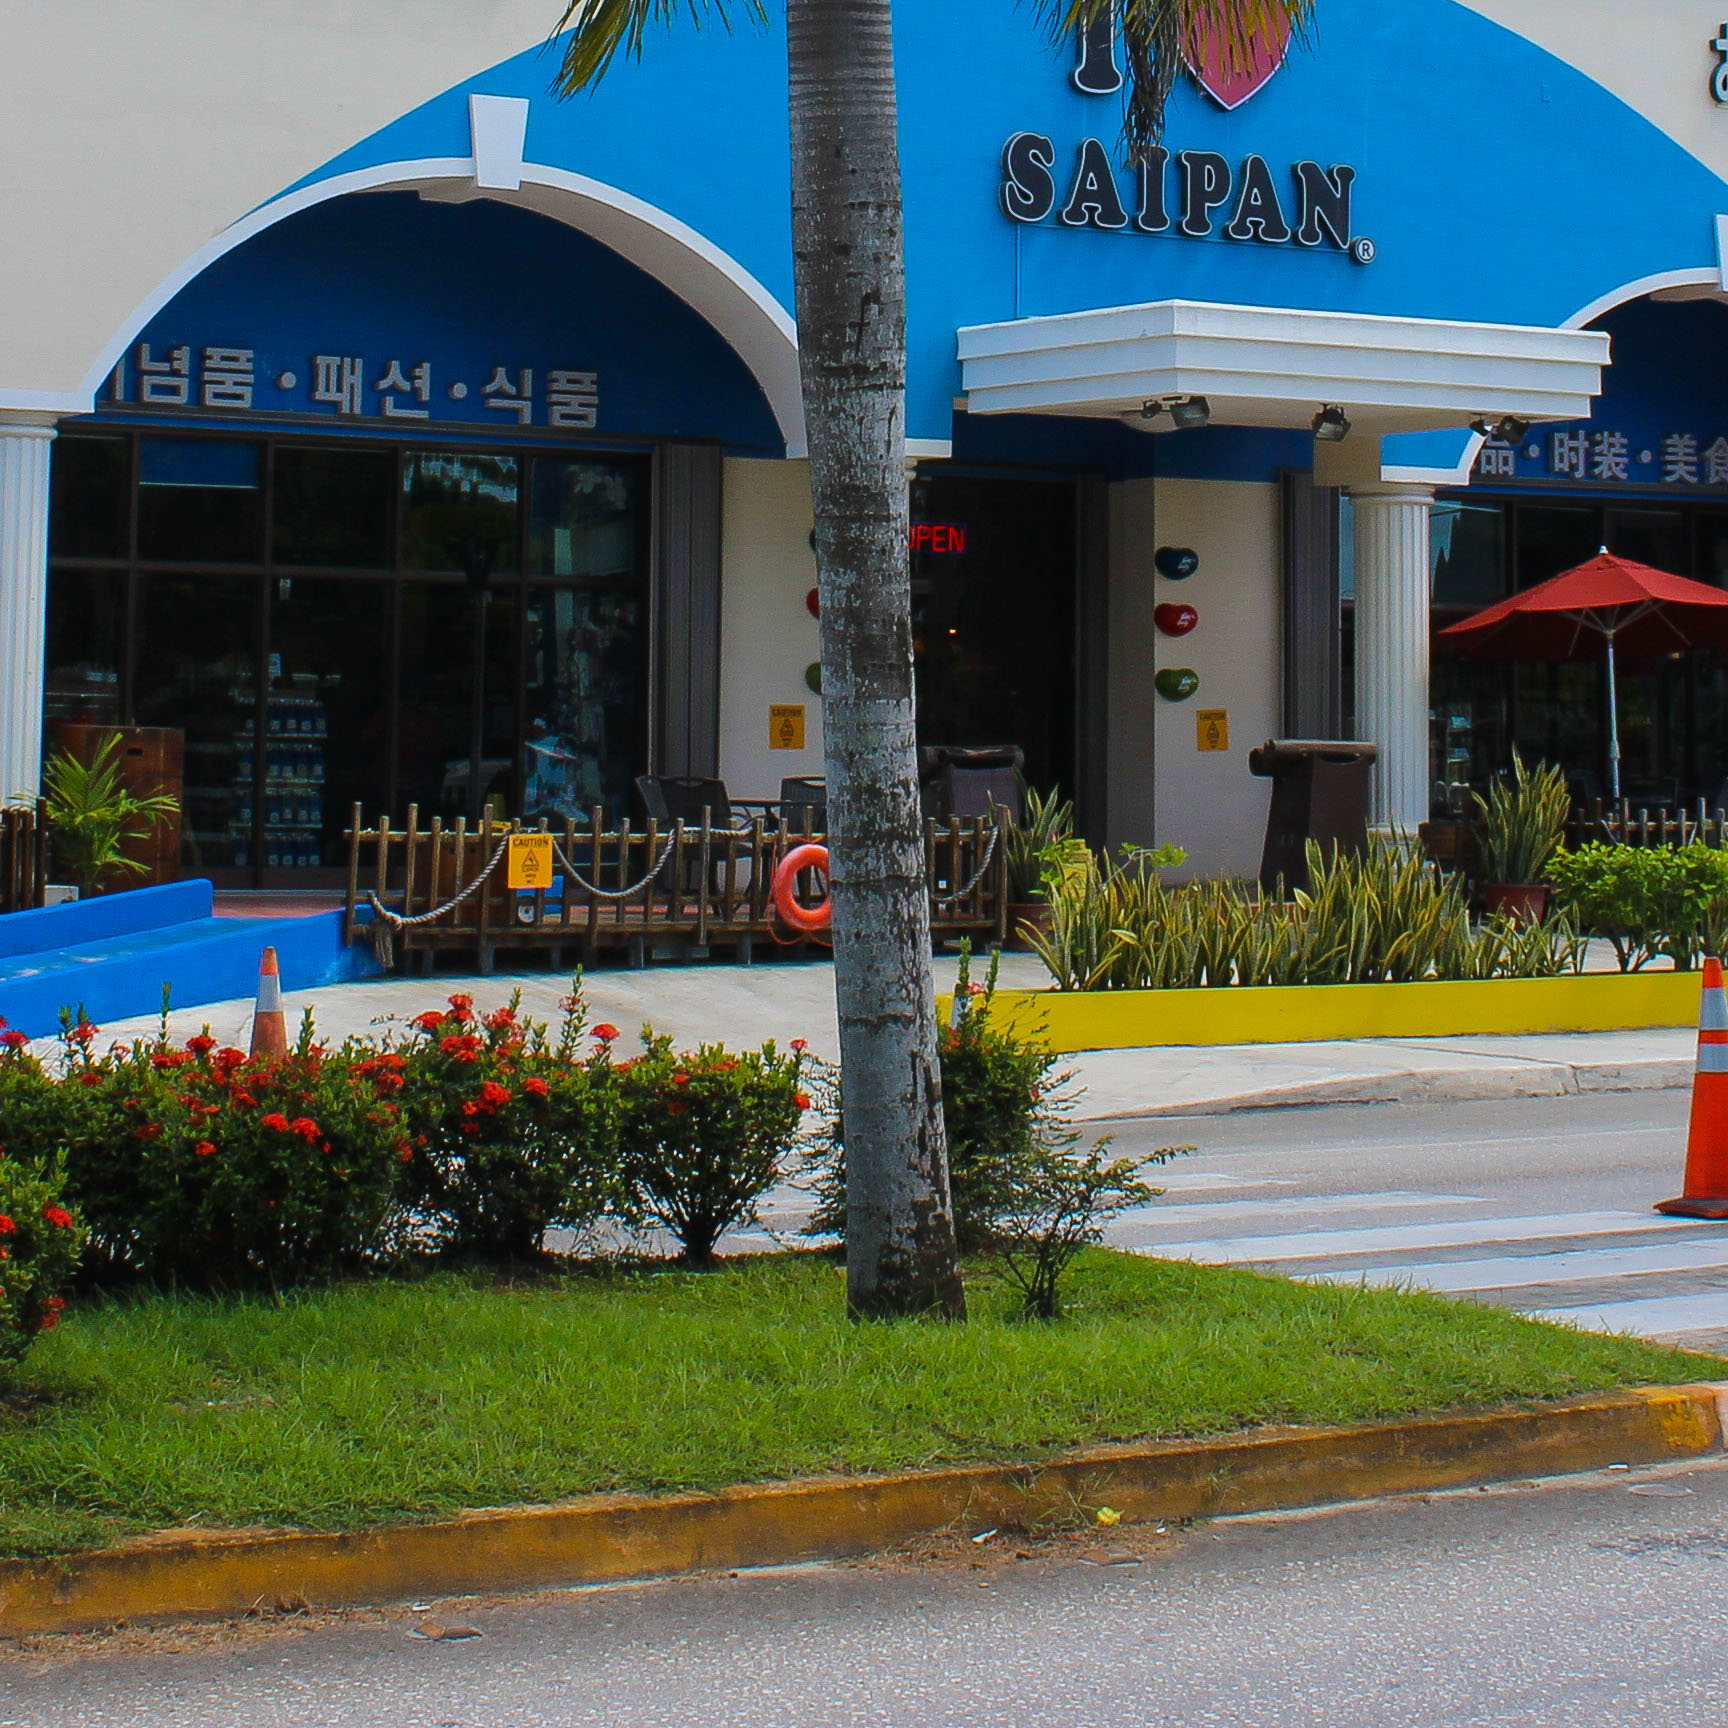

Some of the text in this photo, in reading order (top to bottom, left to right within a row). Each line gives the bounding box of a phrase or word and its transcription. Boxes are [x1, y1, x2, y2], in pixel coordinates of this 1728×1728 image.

[312, 355, 432, 421] 패션
[481, 367, 600, 430] 식품
[512, 837, 549, 848] CAUTION
